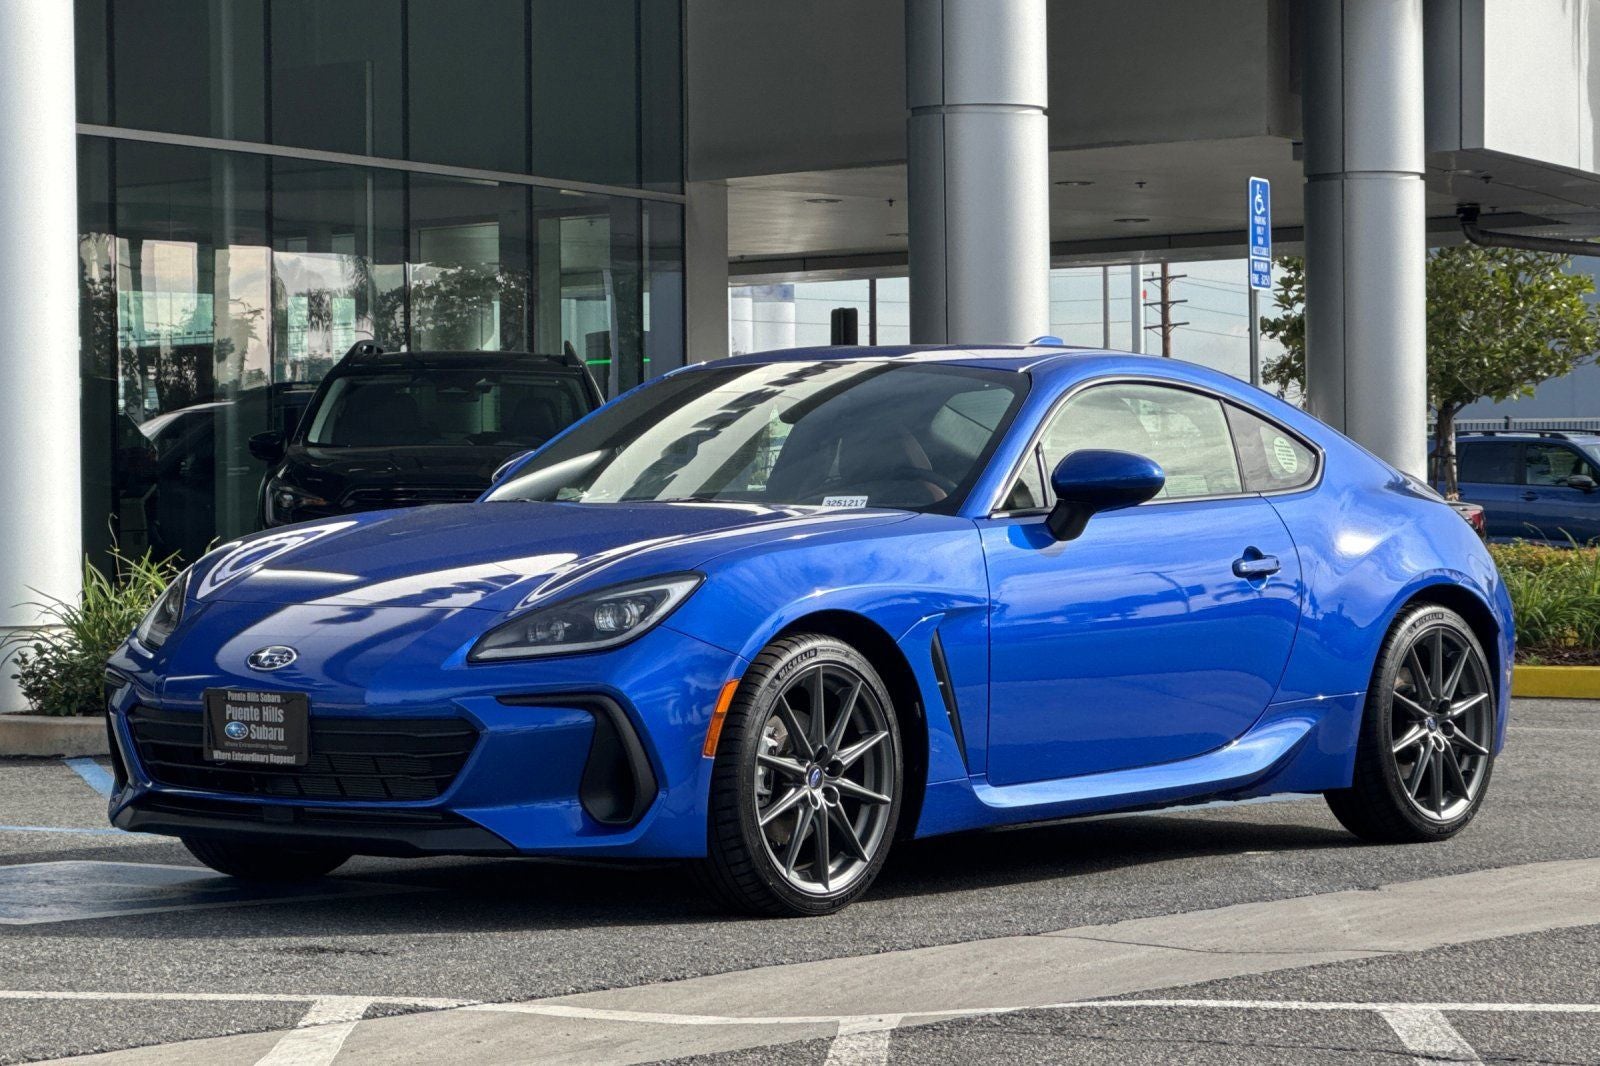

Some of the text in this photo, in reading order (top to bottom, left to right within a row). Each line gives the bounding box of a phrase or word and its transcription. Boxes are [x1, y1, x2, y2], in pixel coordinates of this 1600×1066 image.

[777, 647, 817, 679] MICHELIN
[227, 691, 281, 703] Puente Hills Subaru
[225, 704, 284, 723] Puente Hills
[250, 724, 284, 741] Subaru
[212, 749, 232, 760] Where
[232, 751, 269, 763] Extraordinary
